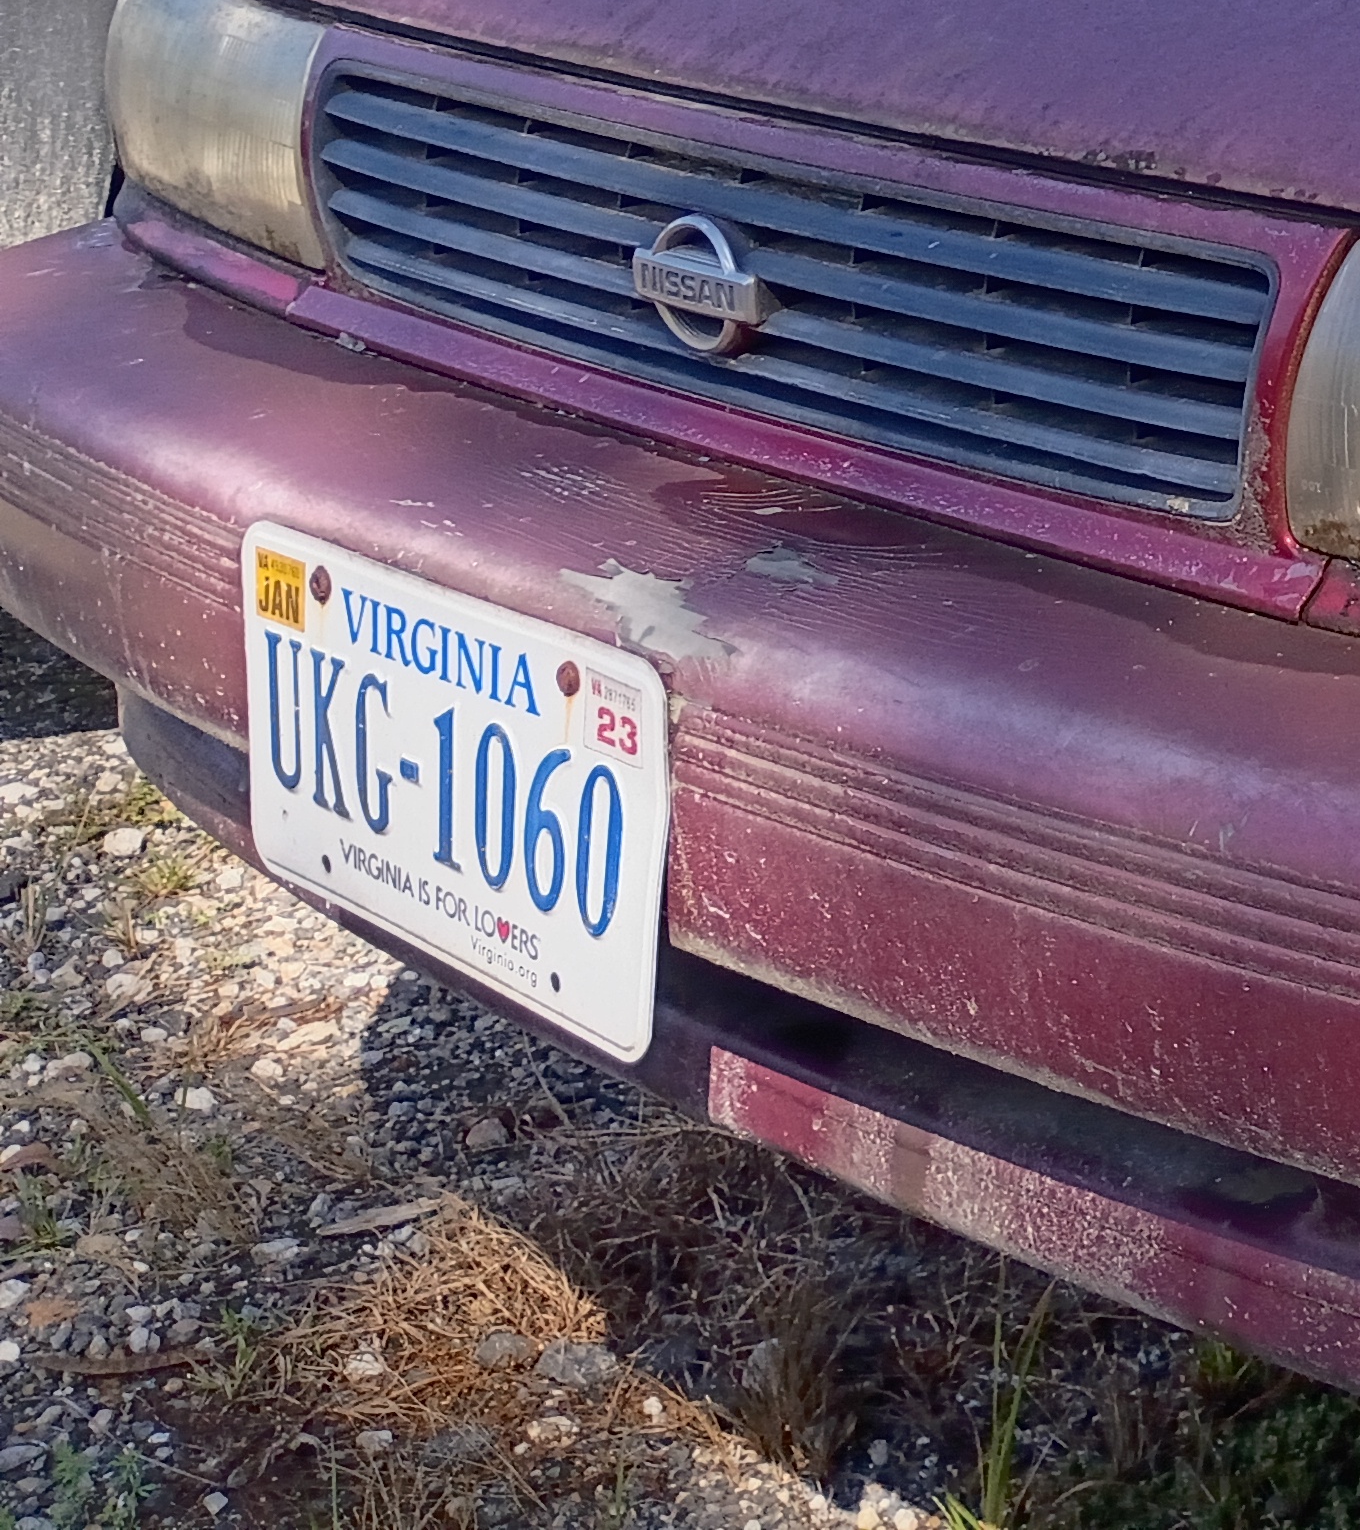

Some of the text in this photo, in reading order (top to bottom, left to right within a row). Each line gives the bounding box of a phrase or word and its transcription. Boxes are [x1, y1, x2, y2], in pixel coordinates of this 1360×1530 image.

[639, 262, 736, 312] NISSAN
[258, 576, 300, 624] JAN
[341, 587, 541, 717] VIRGINIA
[597, 706, 637, 756] 23
[265, 629, 624, 939] UKG-1060
[339, 838, 414, 898] VIRGINIA
[418, 877, 430, 906] IS
[435, 885, 470, 926] FOR
[471, 935, 537, 988] Virginia.org
